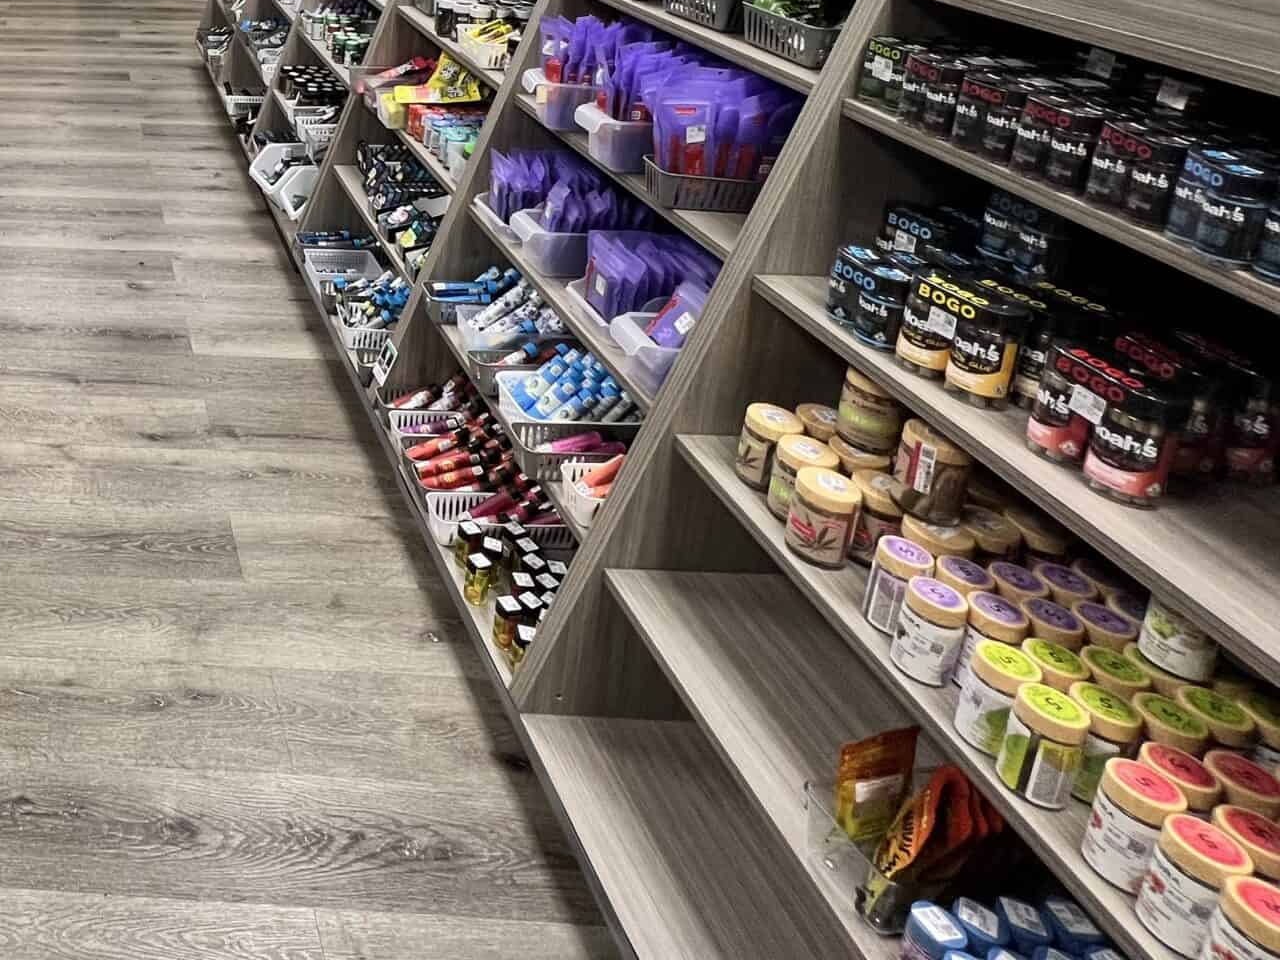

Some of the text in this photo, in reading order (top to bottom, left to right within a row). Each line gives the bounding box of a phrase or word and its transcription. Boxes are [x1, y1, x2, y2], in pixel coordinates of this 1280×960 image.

[869, 41, 901, 61] BOGO
[1184, 158, 1224, 187] BOGO
[887, 212, 933, 241] BOGO
[834, 259, 876, 292] BOGO
[918, 282, 977, 320] BOGO
[954, 335, 1001, 363] oah's
[1095, 423, 1159, 459] oah's
